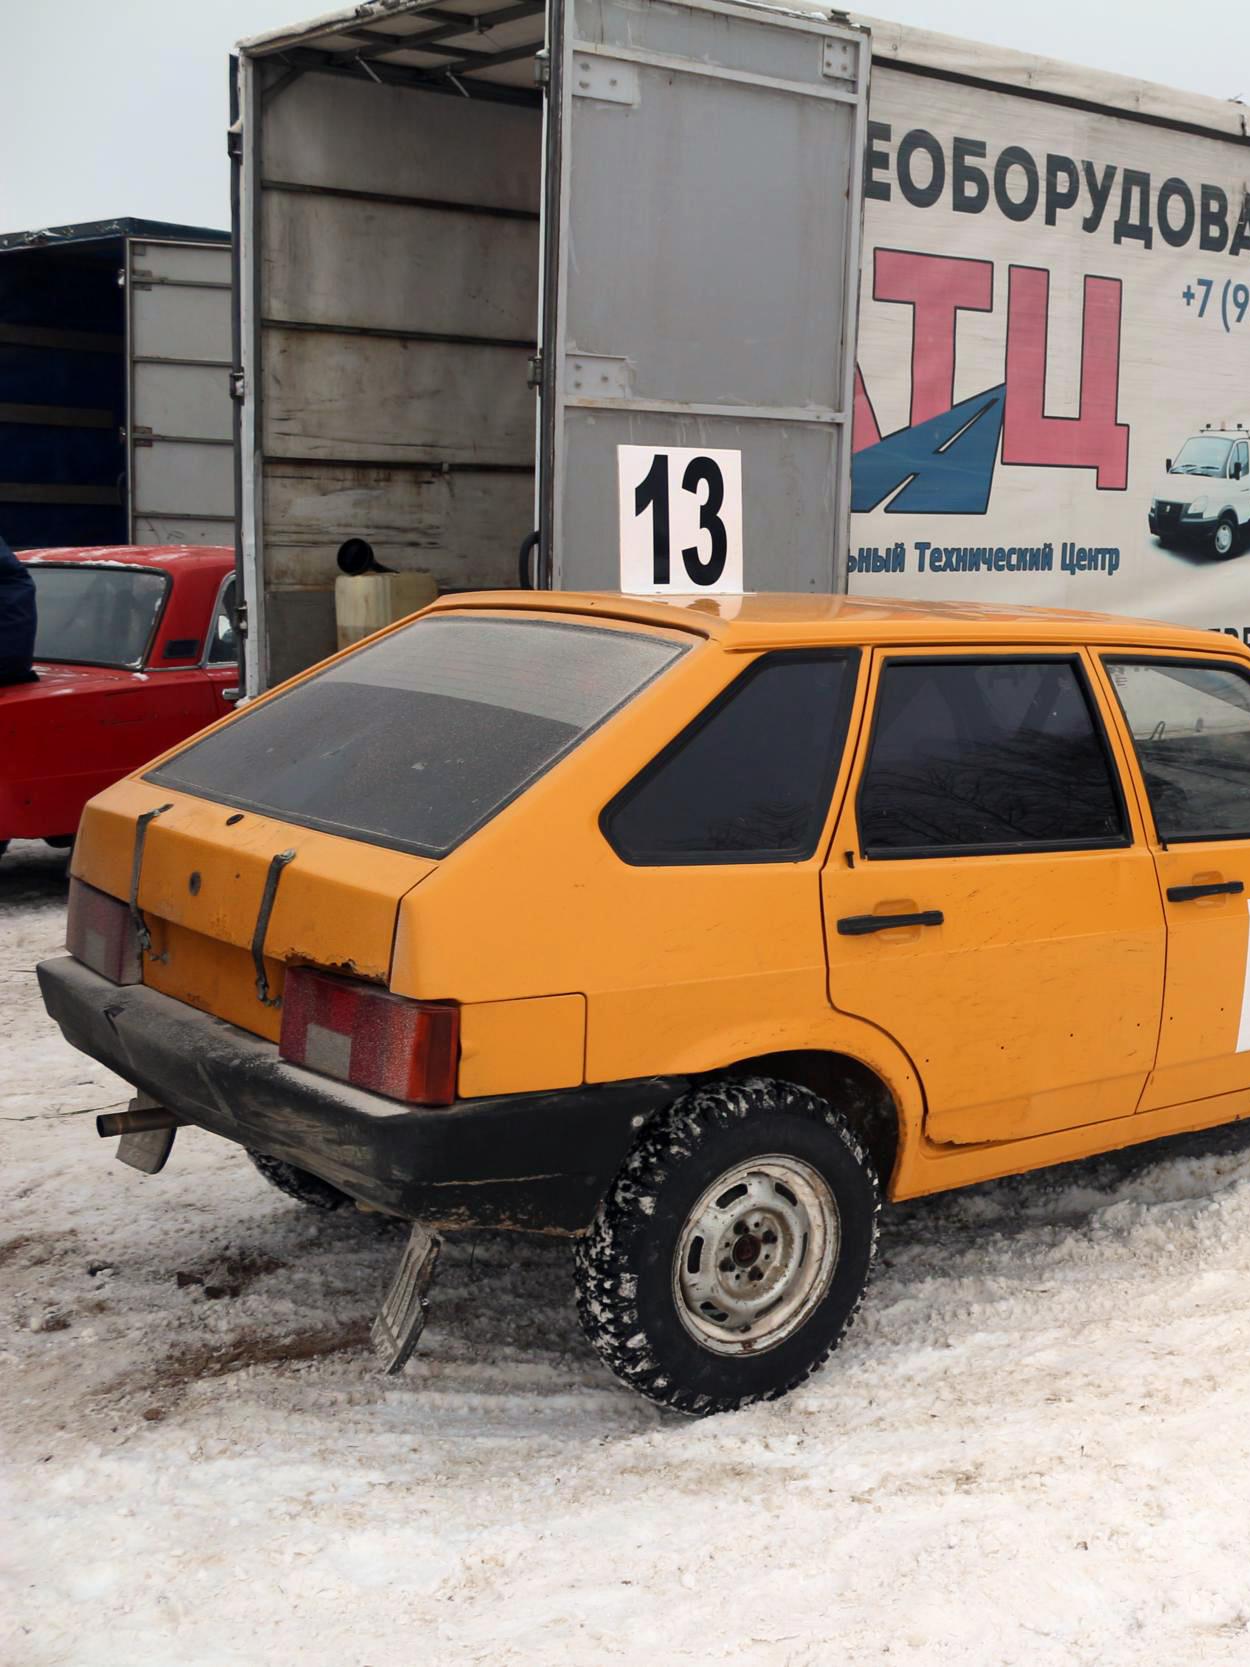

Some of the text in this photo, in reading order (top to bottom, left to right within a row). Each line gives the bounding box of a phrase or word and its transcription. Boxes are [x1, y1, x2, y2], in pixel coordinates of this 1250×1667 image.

[1182, 278, 1214, 318] +7
[635, 454, 728, 586] 13
[914, 542, 1053, 573] Технический
[1060, 542, 1120, 576] Центр
